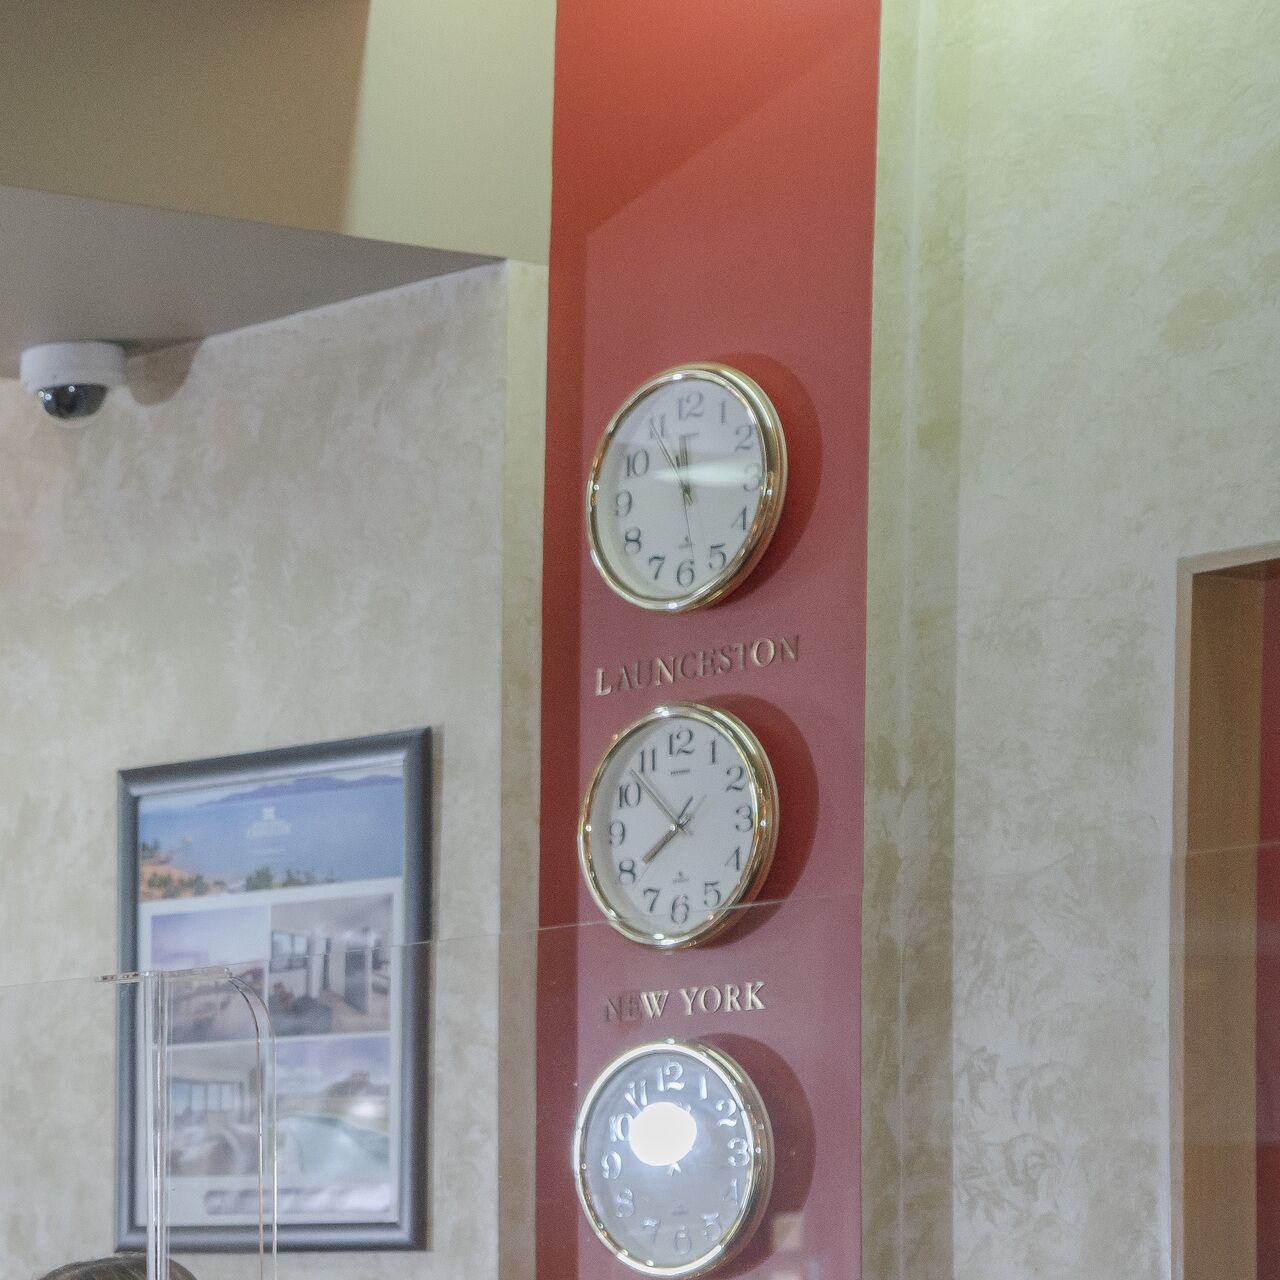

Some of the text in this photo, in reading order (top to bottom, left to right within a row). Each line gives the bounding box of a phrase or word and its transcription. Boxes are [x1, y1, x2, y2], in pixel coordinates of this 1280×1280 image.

[677, 390, 704, 421] 12
[719, 400, 727, 424] 1
[735, 424, 754, 452] 2
[625, 449, 649, 478] 10
[743, 464, 761, 492] 3
[615, 490, 632, 517] 9
[624, 528, 641, 554] 8
[649, 556, 665, 580] 7
[708, 544, 727, 569] 5
[676, 560, 695, 587] 6
[594, 635, 800, 697] LAUNCESTON
[668, 727, 694, 757] 12
[710, 738, 718, 765] 1
[640, 747, 657, 773] 11
[725, 765, 744, 792] 2
[618, 782, 641, 809] 10
[735, 805, 753, 832] 3
[609, 821, 625, 846] 9
[618, 859, 636, 884] 8
[726, 848, 741, 871] 4
[643, 888, 660, 913] 7
[703, 881, 721, 907] 5
[670, 894, 689, 924] 6
[604, 981, 766, 1023] NEW YORK
[657, 1061, 685, 1091] 12
[699, 1074, 708, 1100] 1
[715, 1099, 737, 1127] 2
[601, 1151, 622, 1179] 9
[728, 1138, 749, 1167] 3
[616, 1188, 635, 1218] 8
